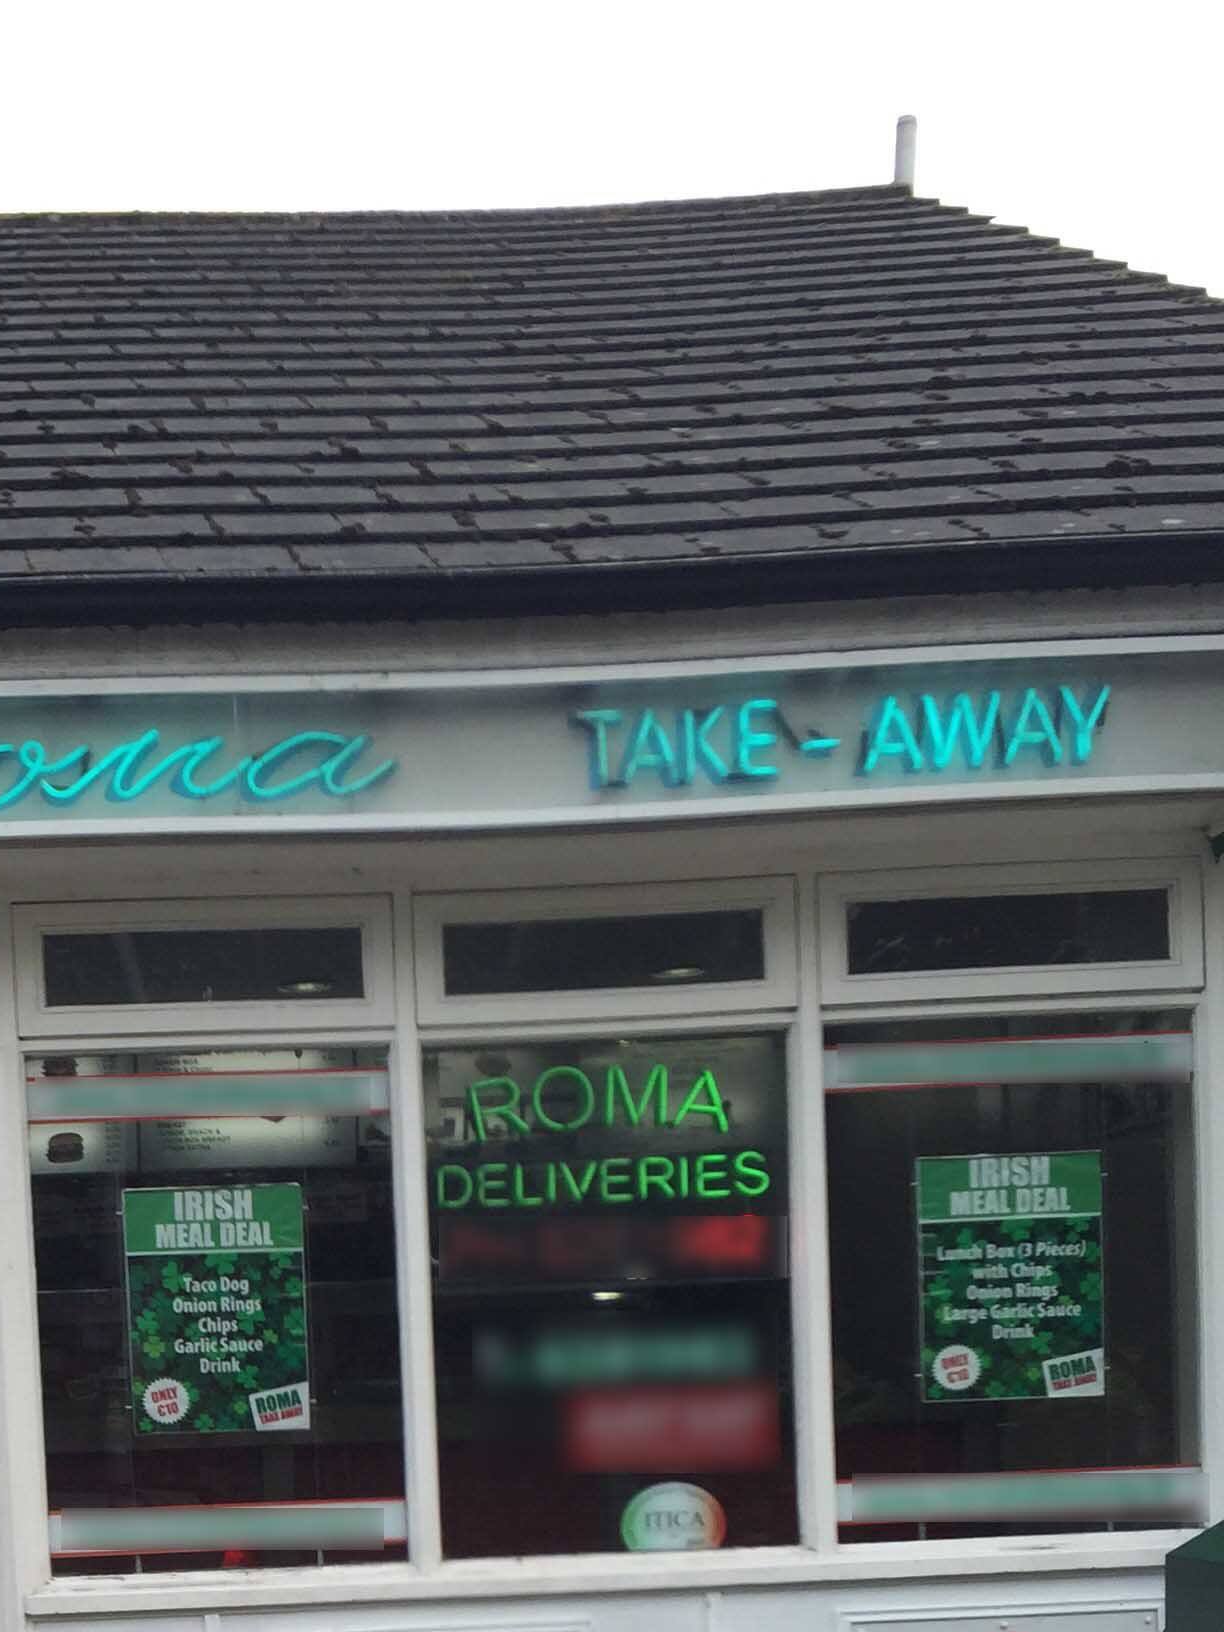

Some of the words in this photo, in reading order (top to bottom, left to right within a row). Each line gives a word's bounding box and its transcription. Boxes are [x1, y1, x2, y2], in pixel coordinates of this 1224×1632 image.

[466, 1064, 729, 1143] ROMA
[437, 1150, 771, 1208] DELIVERIES
[969, 1155, 1051, 1188] IRISH
[174, 1188, 253, 1221] IRISH
[950, 1189, 1012, 1216] MEAL
[1015, 1187, 1071, 1213] DEAL
[155, 1222, 215, 1249] MEAL
[219, 1221, 274, 1248] DEAL
[936, 1246, 984, 1261] Lunch
[986, 1244, 1015, 1259] Box
[1035, 1239, 1087, 1257] Pieces)
[973, 1263, 1009, 1279] with
[1010, 1262, 1053, 1282] Chips
[183, 1276, 217, 1293] Taco
[220, 1276, 250, 1296] Dog
[966, 1284, 1013, 1300] Onion
[1015, 1282, 1059, 1301] Rings
[172, 1298, 218, 1314] Onion
[219, 1296, 262, 1315] Rings
[942, 1305, 989, 1325] Large
[990, 1303, 1034, 1320] Garlic
[1036, 1301, 1083, 1318] Sauce
[198, 1316, 239, 1335] Chips
[991, 1323, 1034, 1340] Drink
[173, 1337, 218, 1354] Garlic
[220, 1338, 264, 1353] Sauce
[199, 1356, 242, 1374] Drink
[1047, 1355, 1097, 1381] ROMA
[151, 1386, 179, 1404] ONLY
[255, 1389, 303, 1414] ROMA
